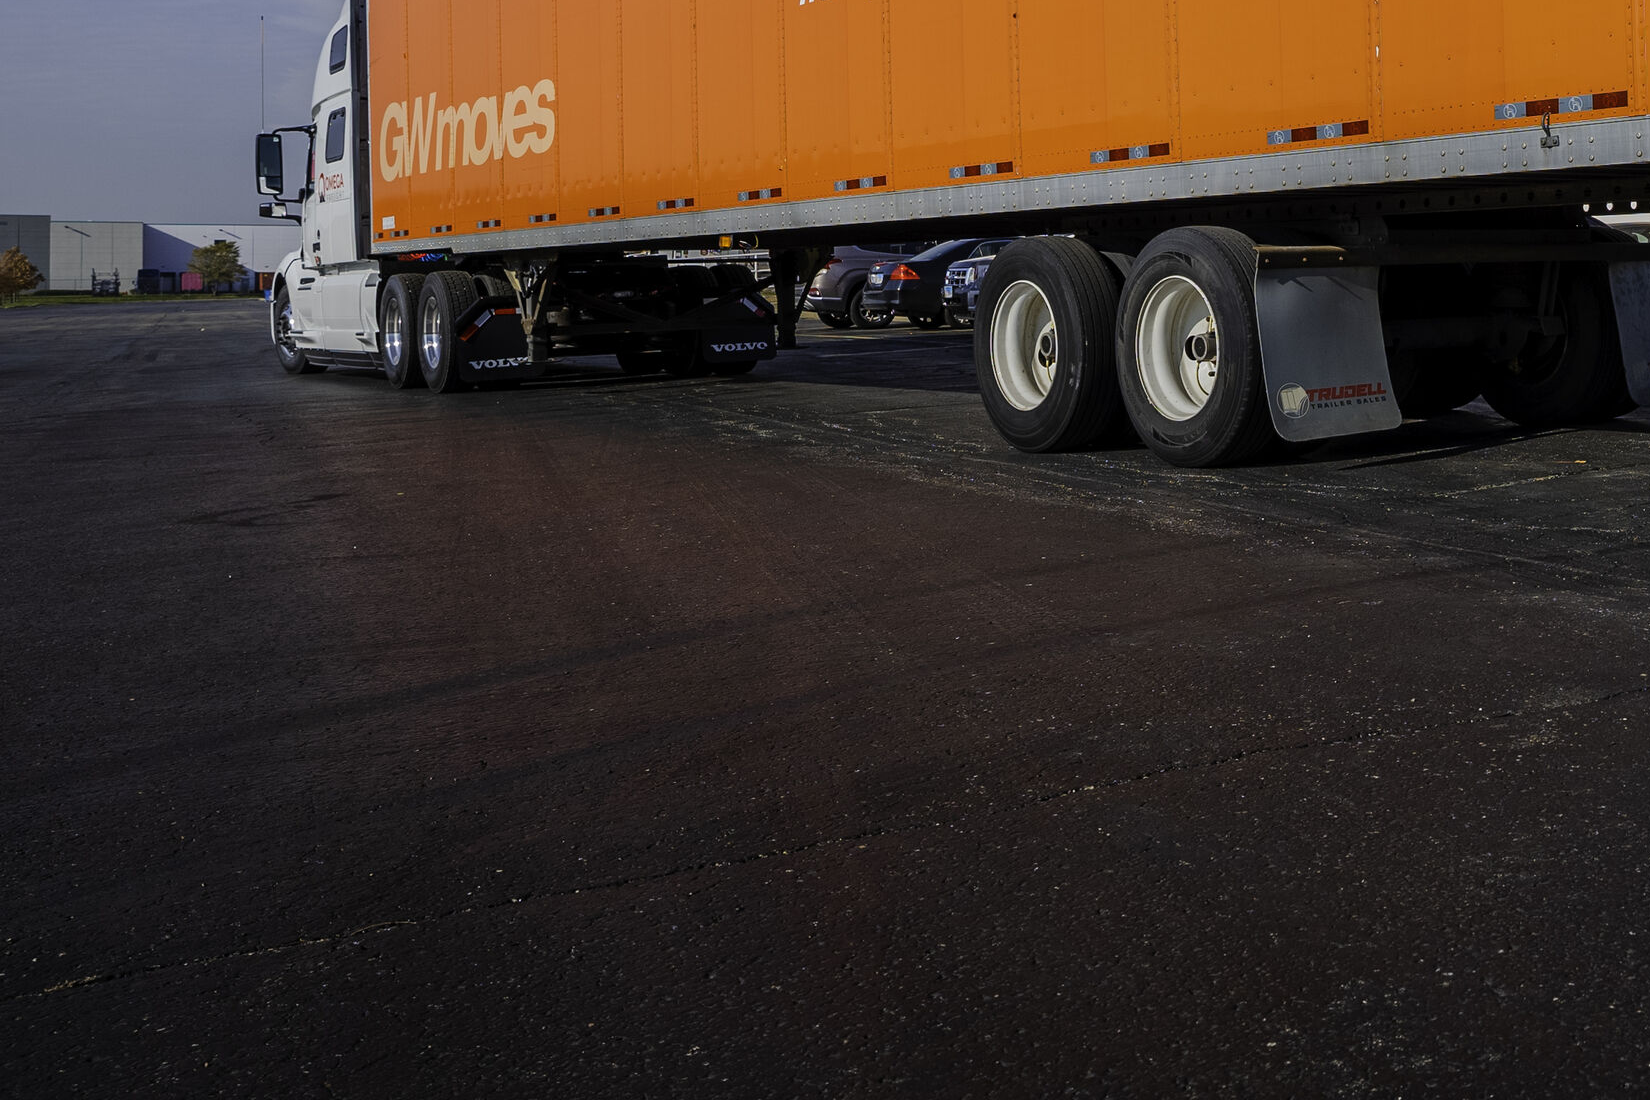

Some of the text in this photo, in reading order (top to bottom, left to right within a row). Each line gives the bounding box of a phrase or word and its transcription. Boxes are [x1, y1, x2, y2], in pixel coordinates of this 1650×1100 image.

[711, 341, 768, 352] VOLVO
[468, 357, 532, 369] VOLV
[1306, 383, 1386, 402] TRUDELL
[1311, 396, 1387, 409] TRAILER SALES
